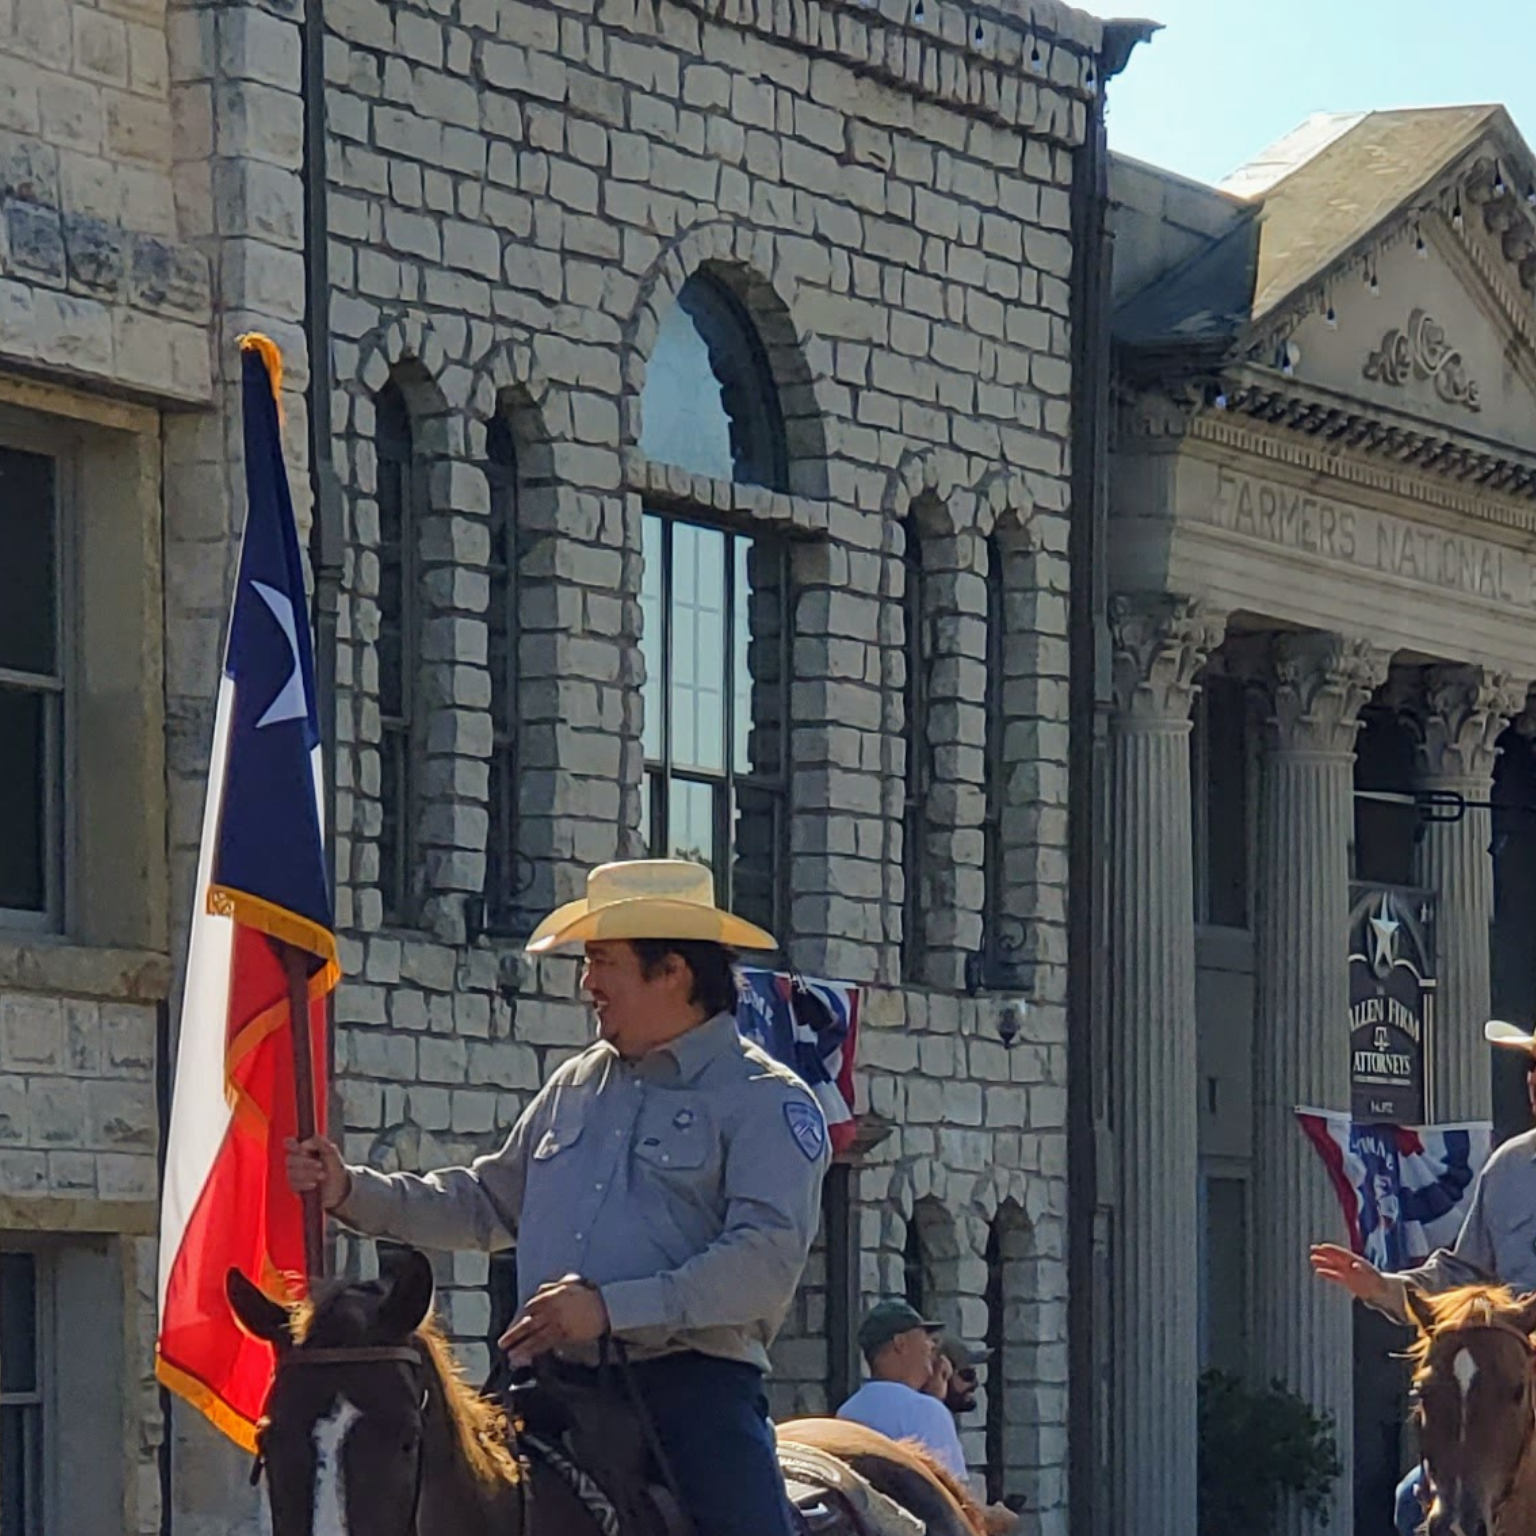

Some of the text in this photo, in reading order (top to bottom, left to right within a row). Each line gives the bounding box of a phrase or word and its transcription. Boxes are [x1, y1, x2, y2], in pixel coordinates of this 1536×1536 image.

[1218, 465, 1355, 561] FARMERS
[1376, 520, 1511, 602] NATIONAL
[1389, 997, 1420, 1043] FIRM
[1353, 1050, 1411, 1075] ATTORNEYS
